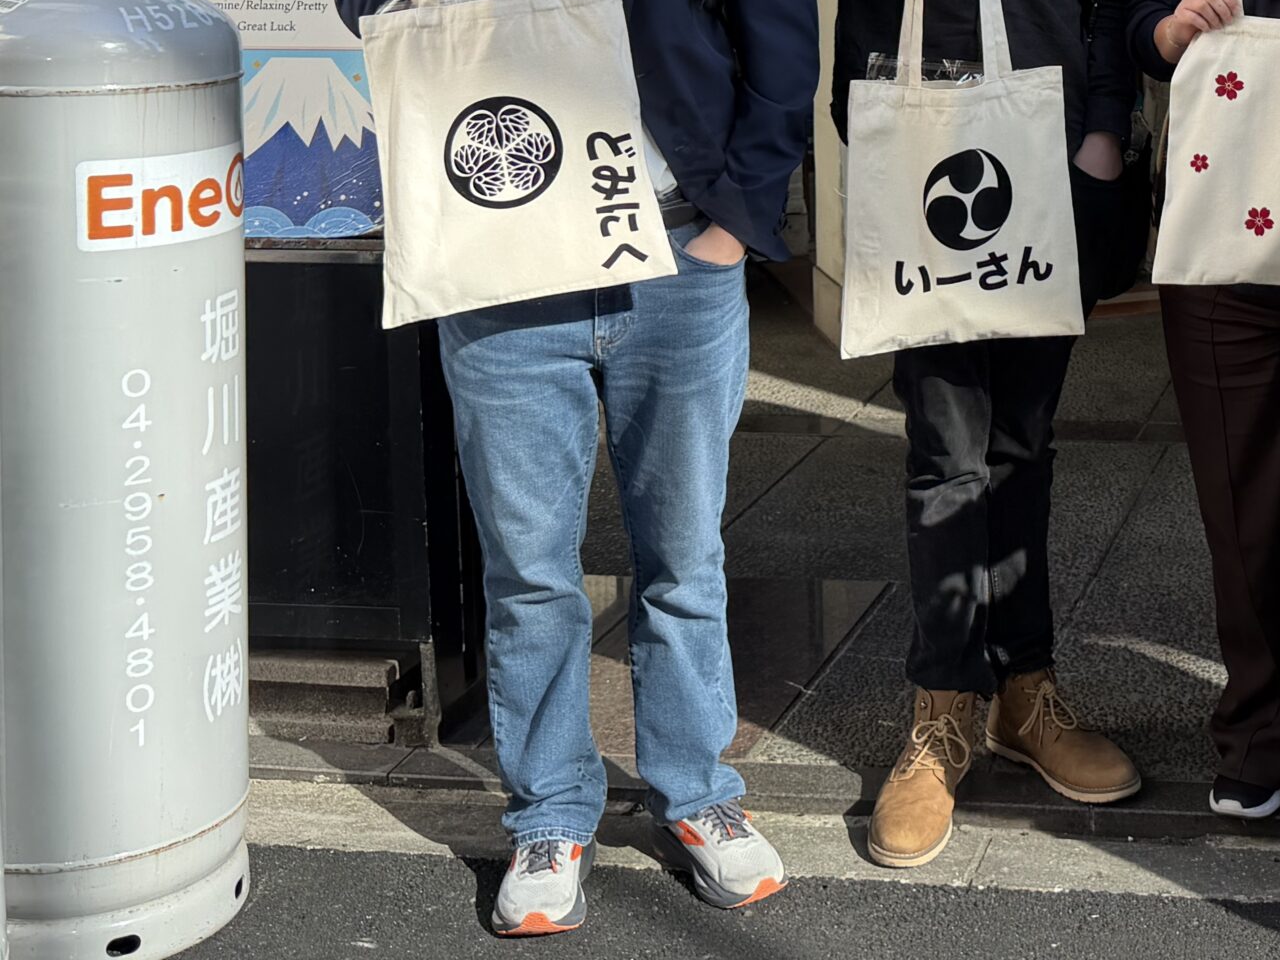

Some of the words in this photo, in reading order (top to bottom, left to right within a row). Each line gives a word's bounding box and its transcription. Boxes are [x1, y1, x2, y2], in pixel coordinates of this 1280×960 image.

[237, 20, 268, 32] Great
[270, 21, 296, 32] Luck
[586, 131, 649, 270] どみにく
[895, 246, 1053, 296] いーさん
